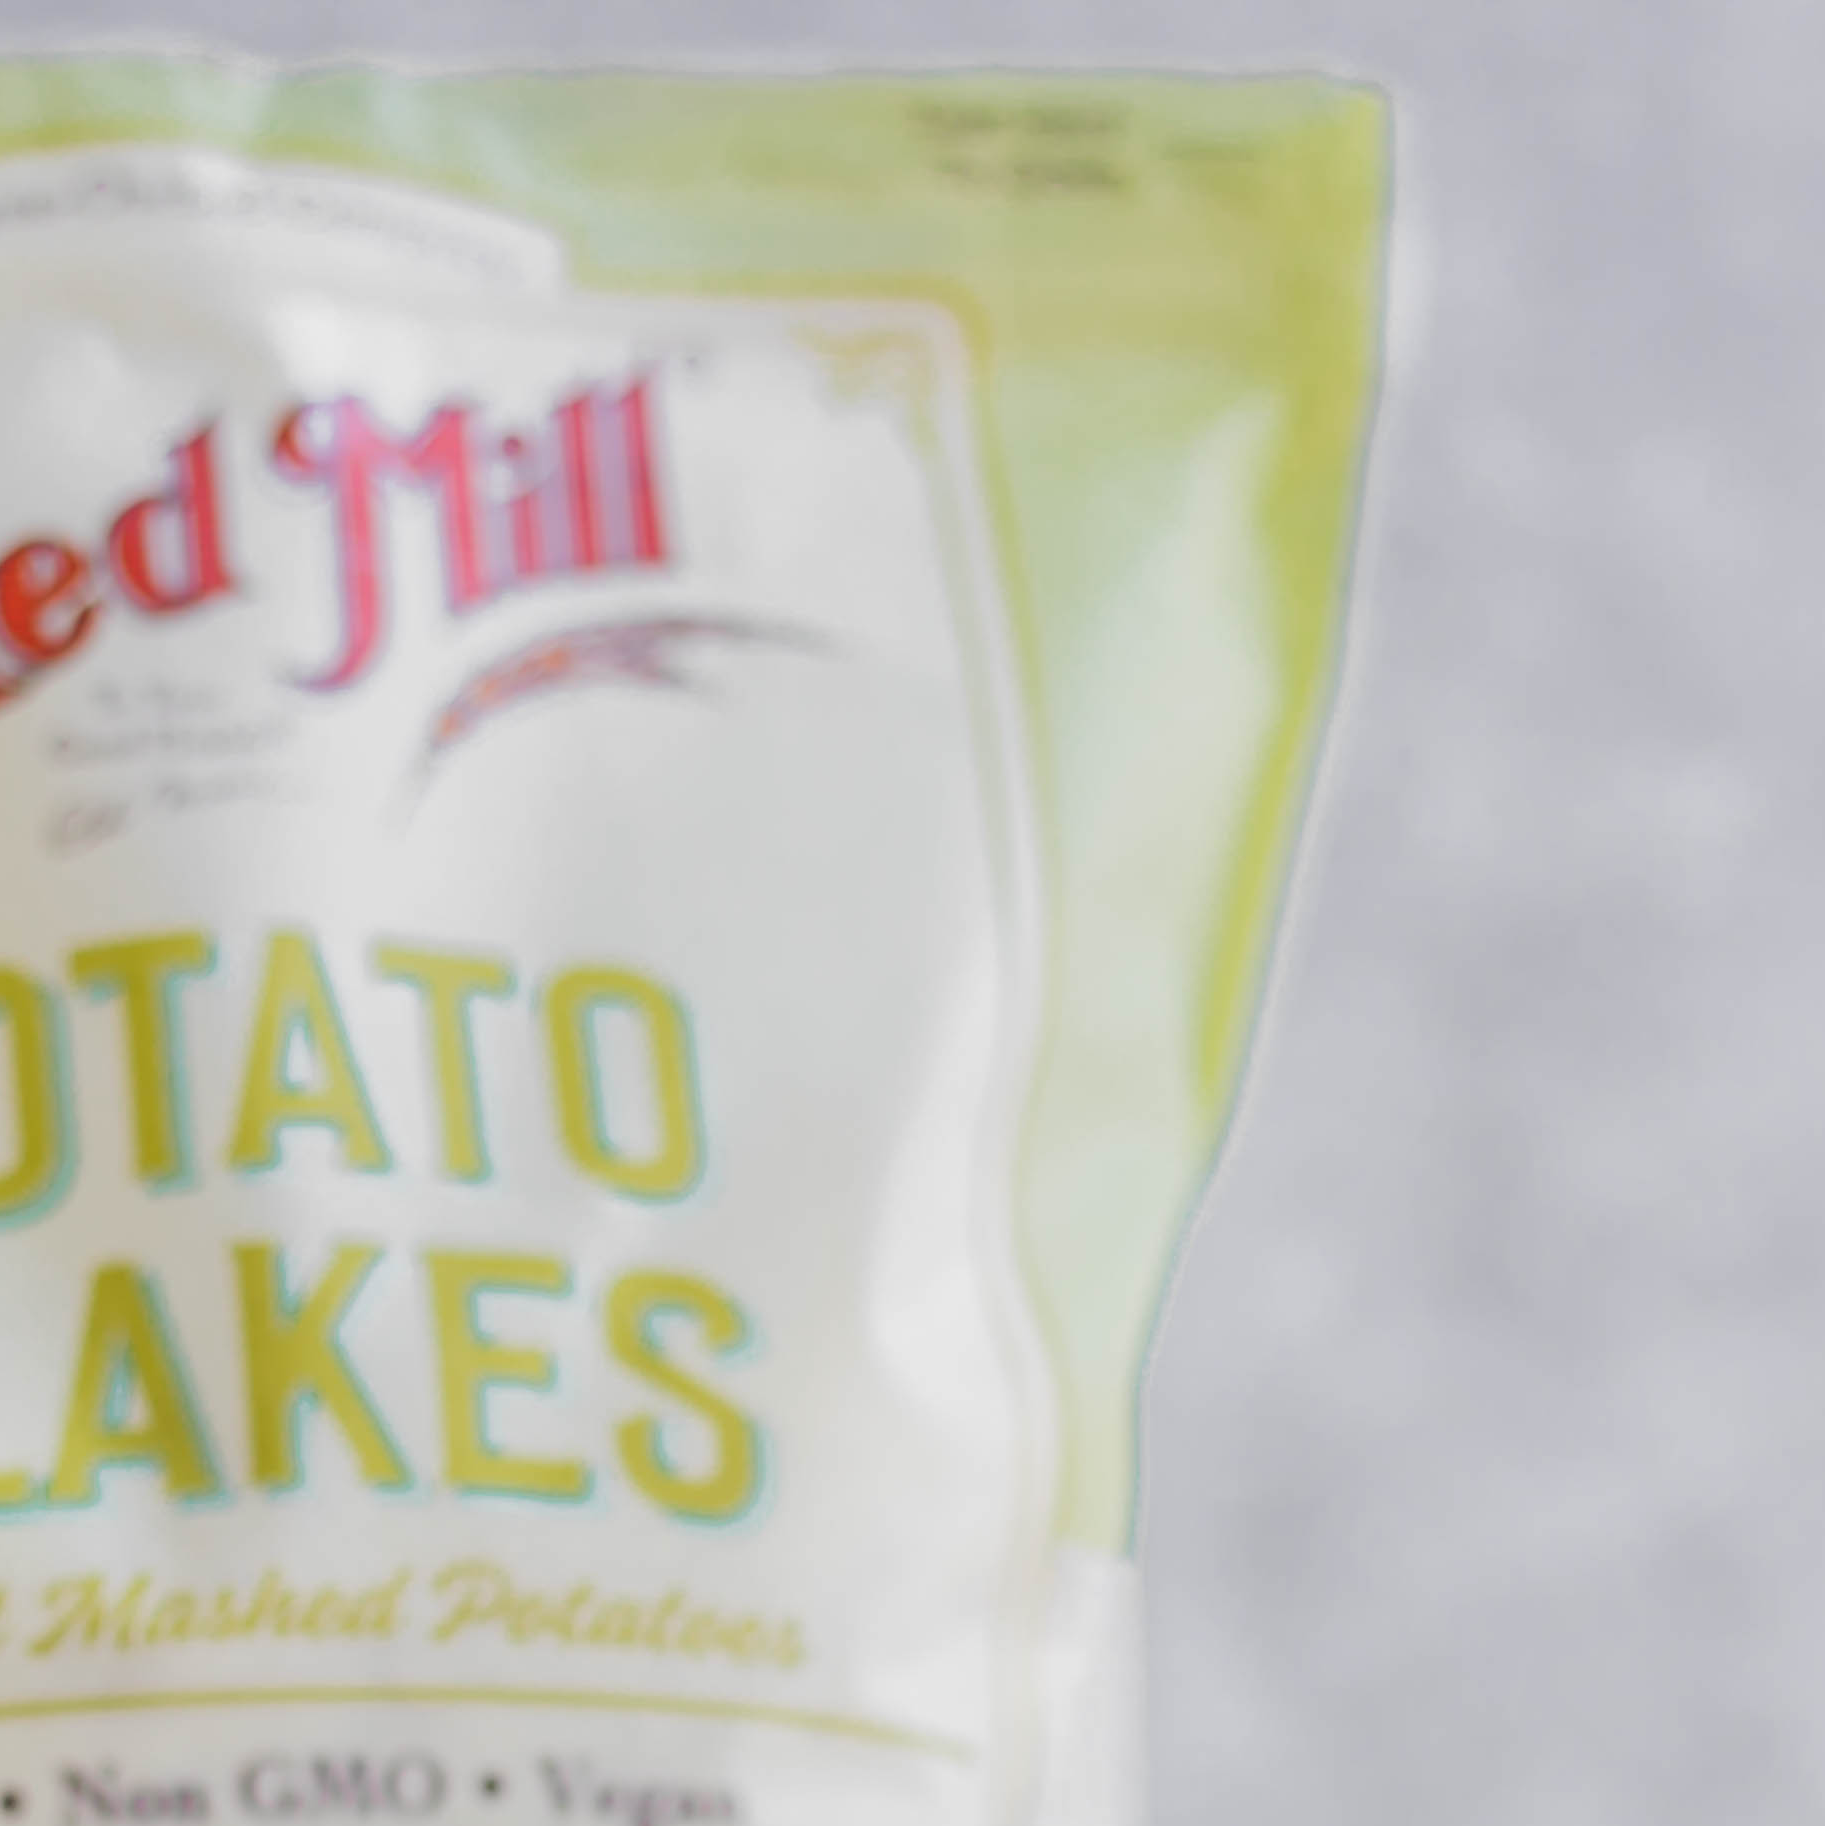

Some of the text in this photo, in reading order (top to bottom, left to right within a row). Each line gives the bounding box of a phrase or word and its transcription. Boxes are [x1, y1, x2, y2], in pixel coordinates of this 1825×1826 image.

[272, 365, 670, 694] Mill
[27, 1562, 412, 1660] Mashed
[432, 1558, 806, 1670] Potatoes
[237, 1748, 449, 1822] GMO
